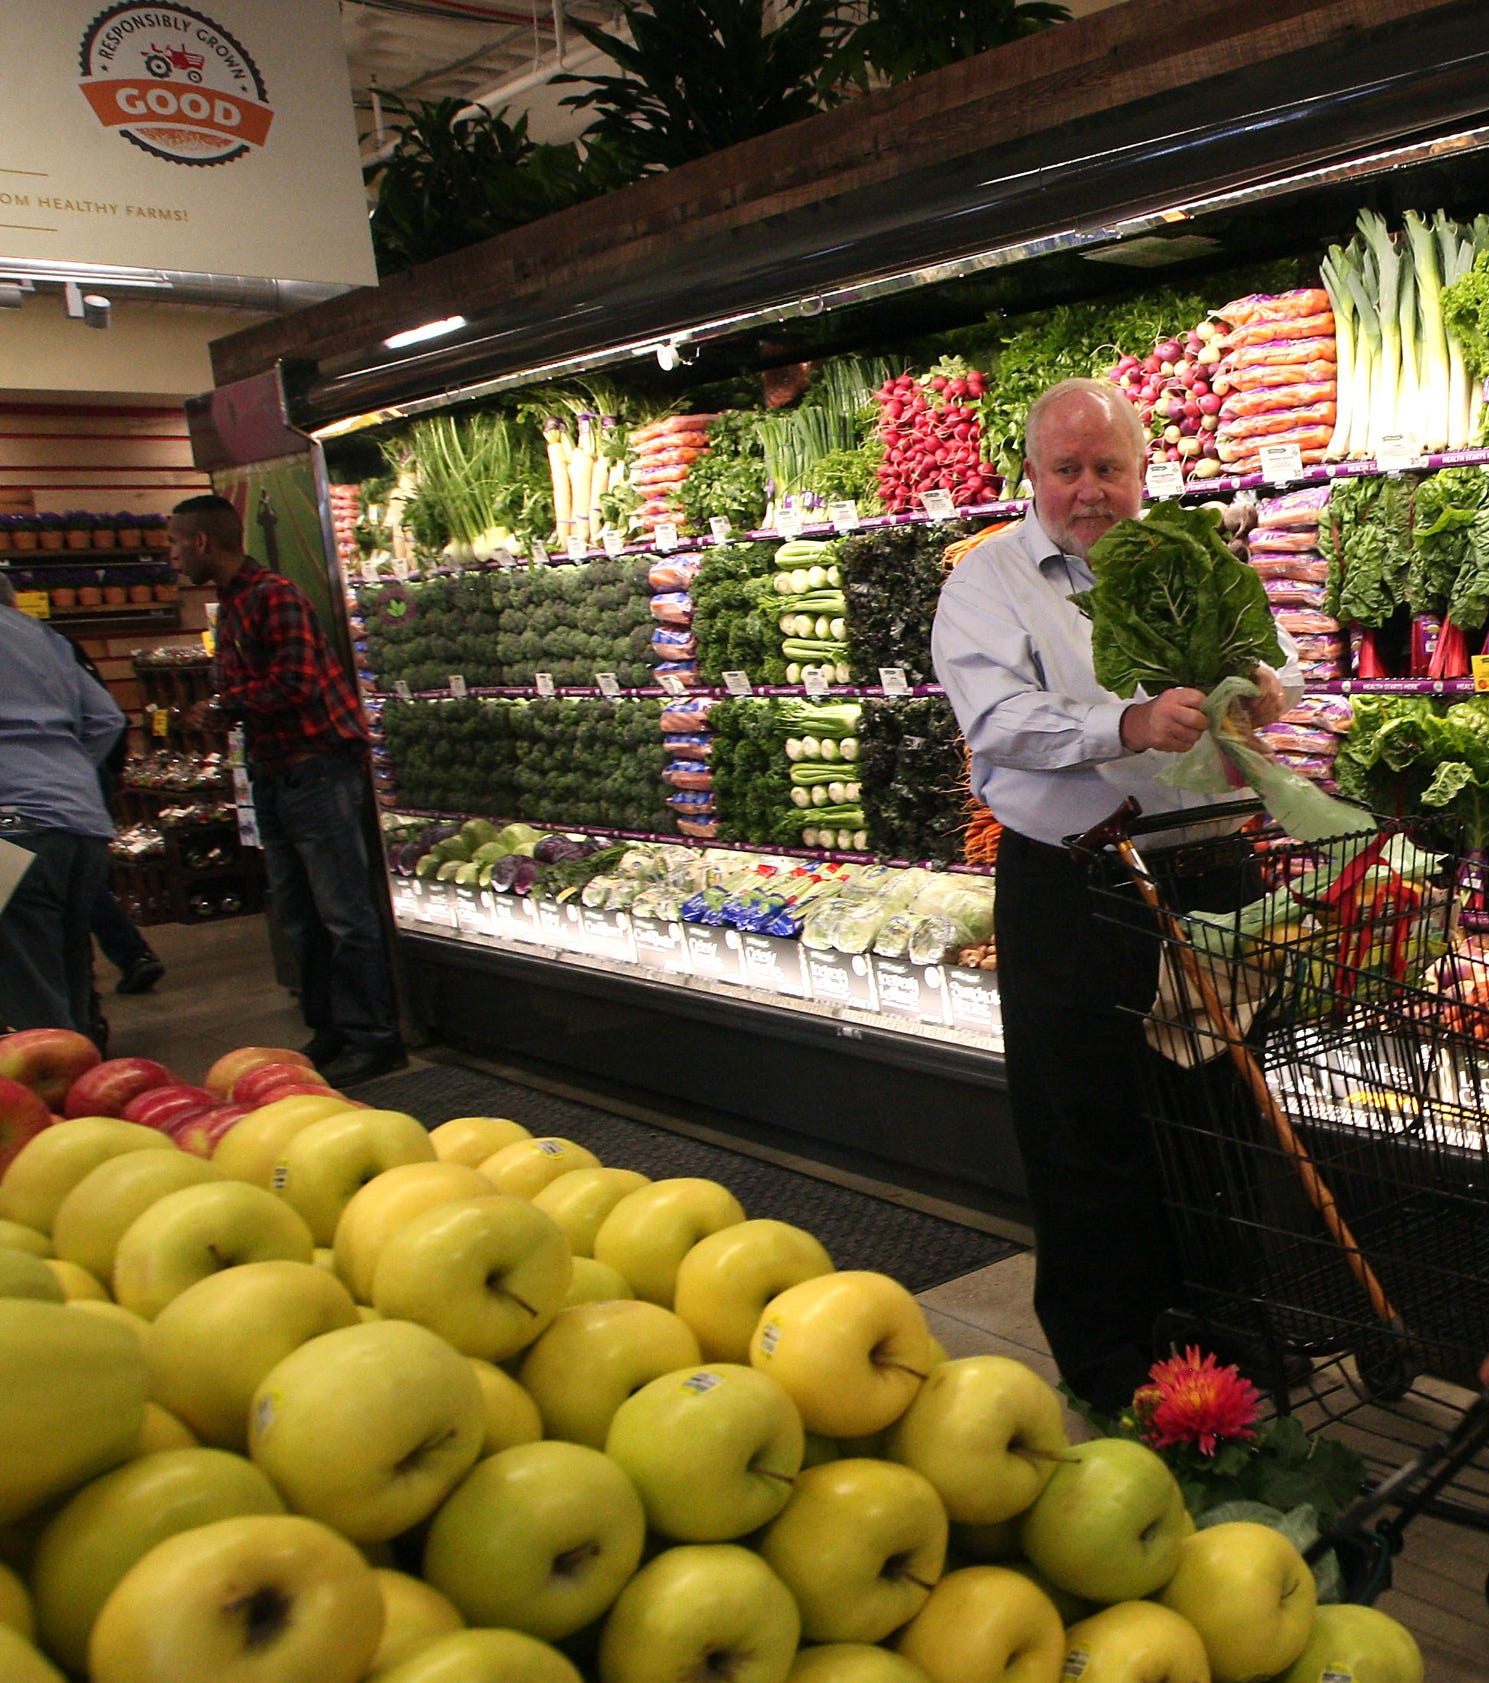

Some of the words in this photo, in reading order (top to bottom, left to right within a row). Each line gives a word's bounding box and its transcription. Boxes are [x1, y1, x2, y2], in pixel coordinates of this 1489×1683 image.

[98, 13, 192, 60] RESPONSIBLY
[196, 28, 246, 80] GROWN
[115, 87, 242, 127] GOOD
[38, 197, 118, 215] HEALTHY
[126, 205, 189, 222] FARMS!
